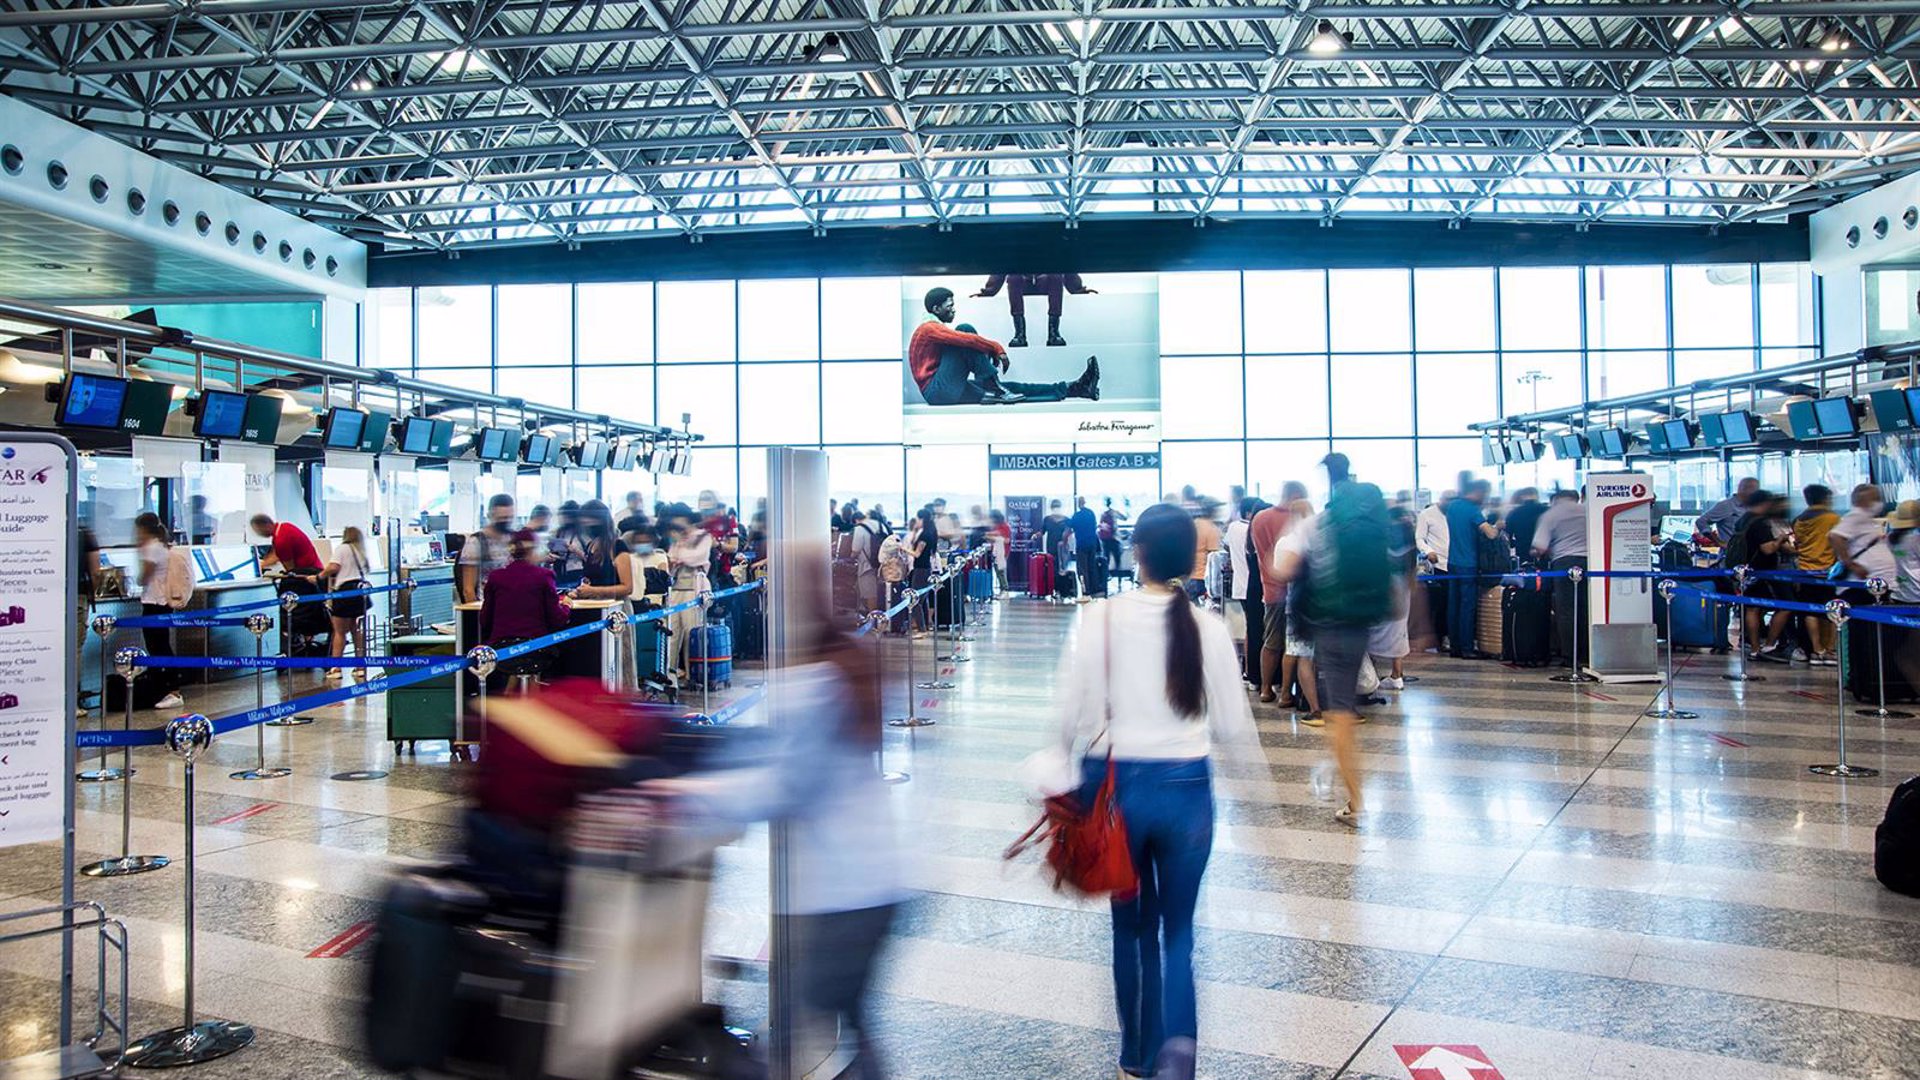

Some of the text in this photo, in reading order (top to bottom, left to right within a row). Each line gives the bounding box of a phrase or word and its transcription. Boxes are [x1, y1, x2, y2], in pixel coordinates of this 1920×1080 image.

[123, 419, 140, 429] 1604
[999, 456, 1071, 468] IMBARCHI
[1075, 455, 1116, 468] Gates
[5, 512, 49, 523] Luggage
[0, 568, 56, 576] usiness Class
[210, 657, 277, 668] Milano Malpensa
[364, 656, 430, 667] Milano Malpensa
[270, 703, 296, 717] Malpensa
